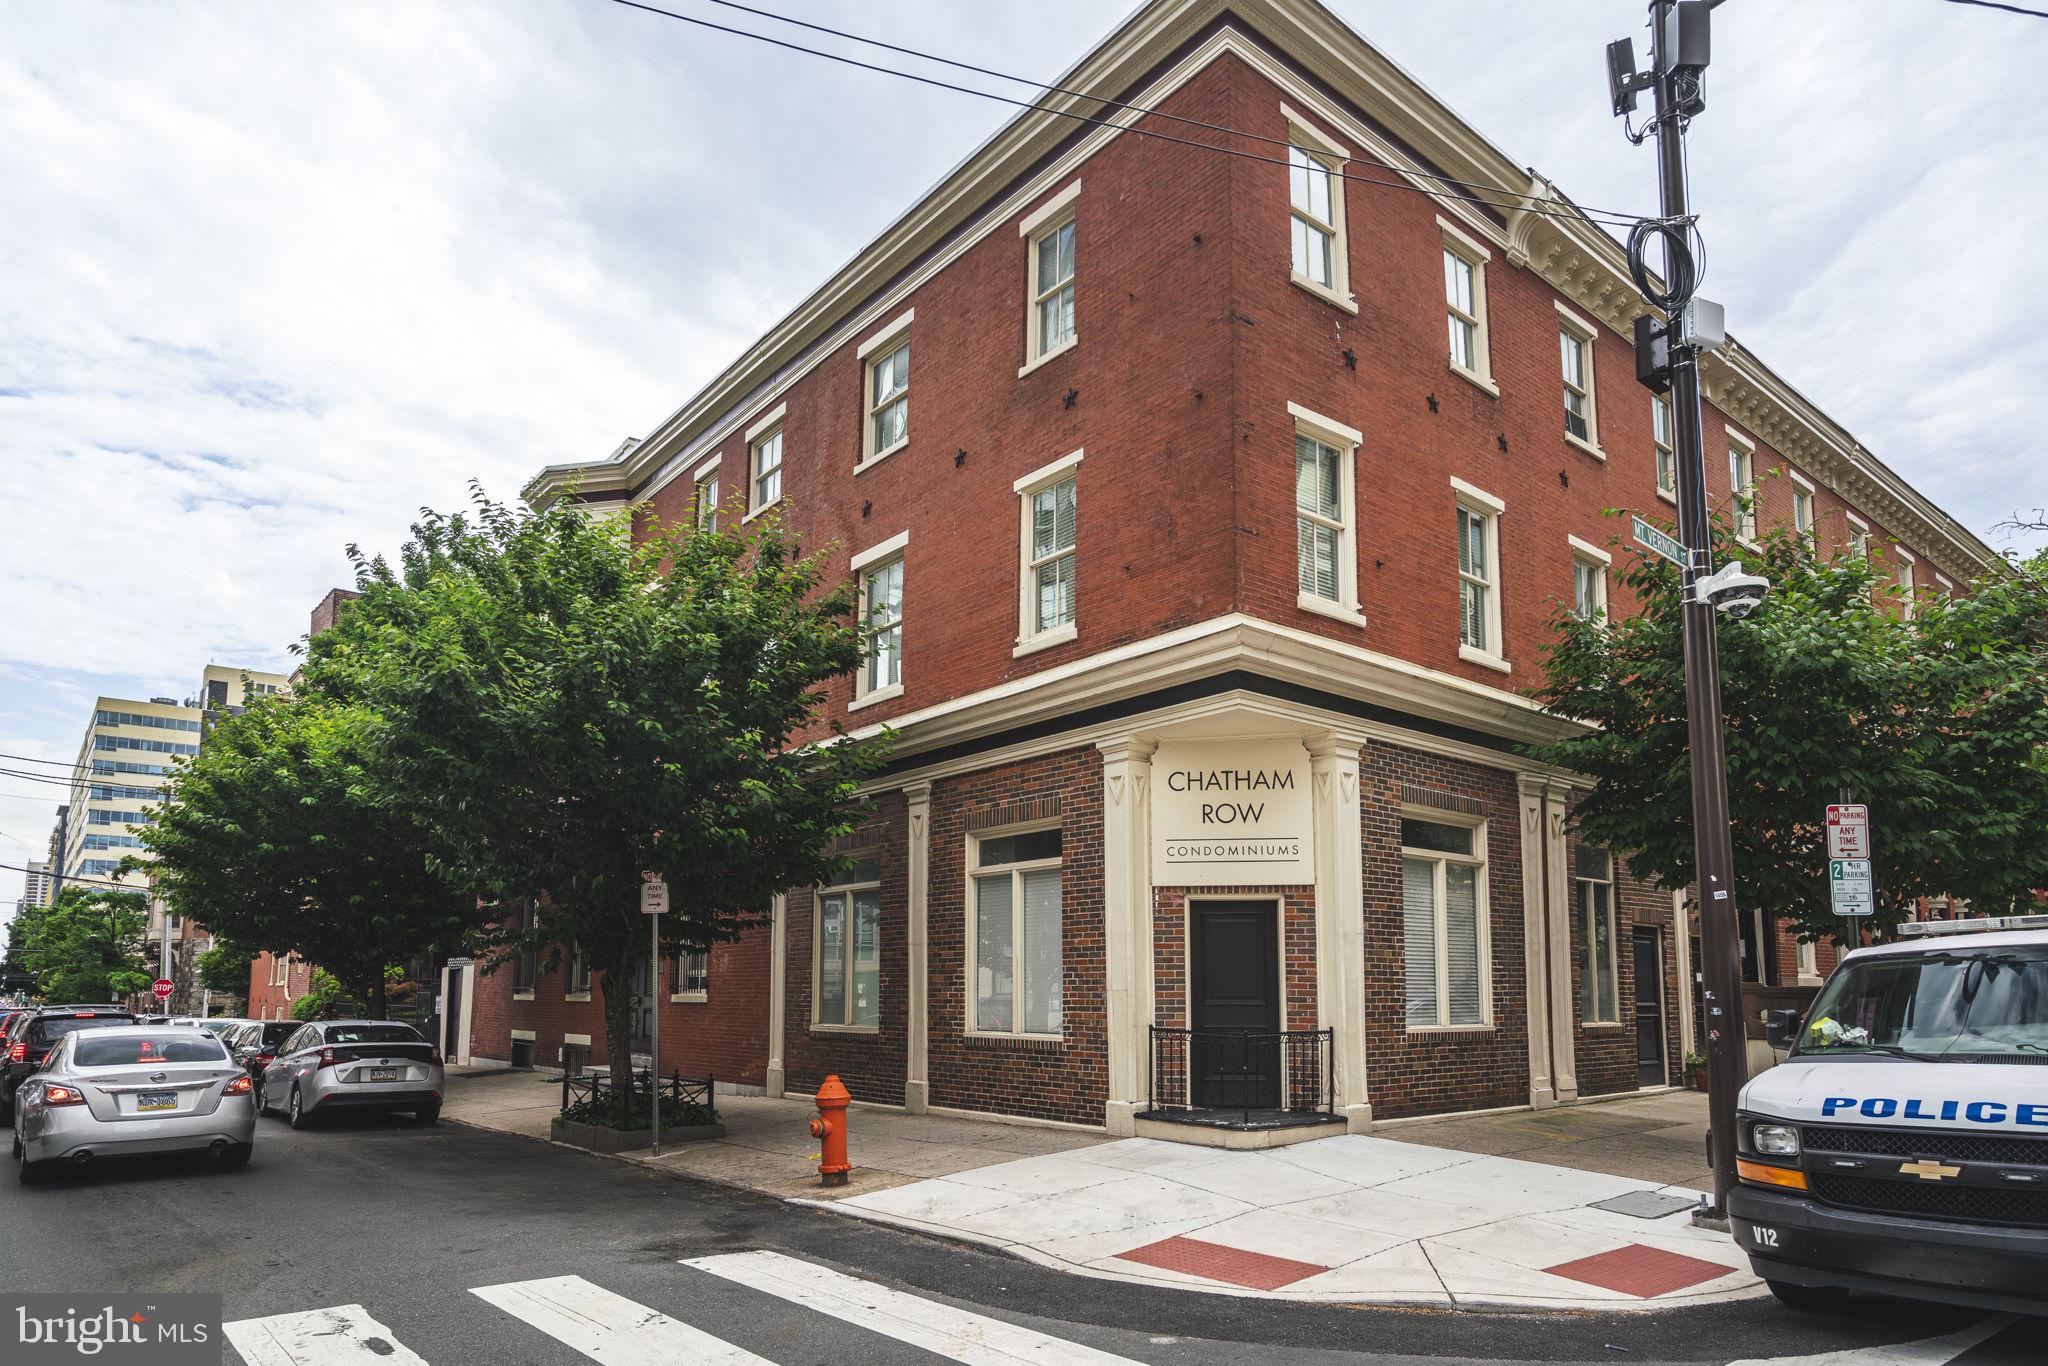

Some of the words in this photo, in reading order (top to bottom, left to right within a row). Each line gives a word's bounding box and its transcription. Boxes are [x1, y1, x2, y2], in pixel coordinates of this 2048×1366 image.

[1634, 521, 1647, 540] MT.
[1647, 528, 1678, 559] VERNON
[1168, 769, 1295, 792] CHATHAM
[1202, 802, 1264, 824] ROW
[1828, 811, 1839, 821] NO
[1840, 811, 1865, 820] PARKING
[1839, 827, 1855, 835] ANY
[1838, 836, 1858, 846] TIME
[1166, 844, 1299, 857] CONDOMINIUMS
[1833, 864, 1841, 878] 2
[1851, 862, 1862, 870] HR
[1843, 871, 1868, 879] PARKING
[1821, 1097, 2048, 1126] POLICE
[1752, 1225, 1779, 1247] V12
